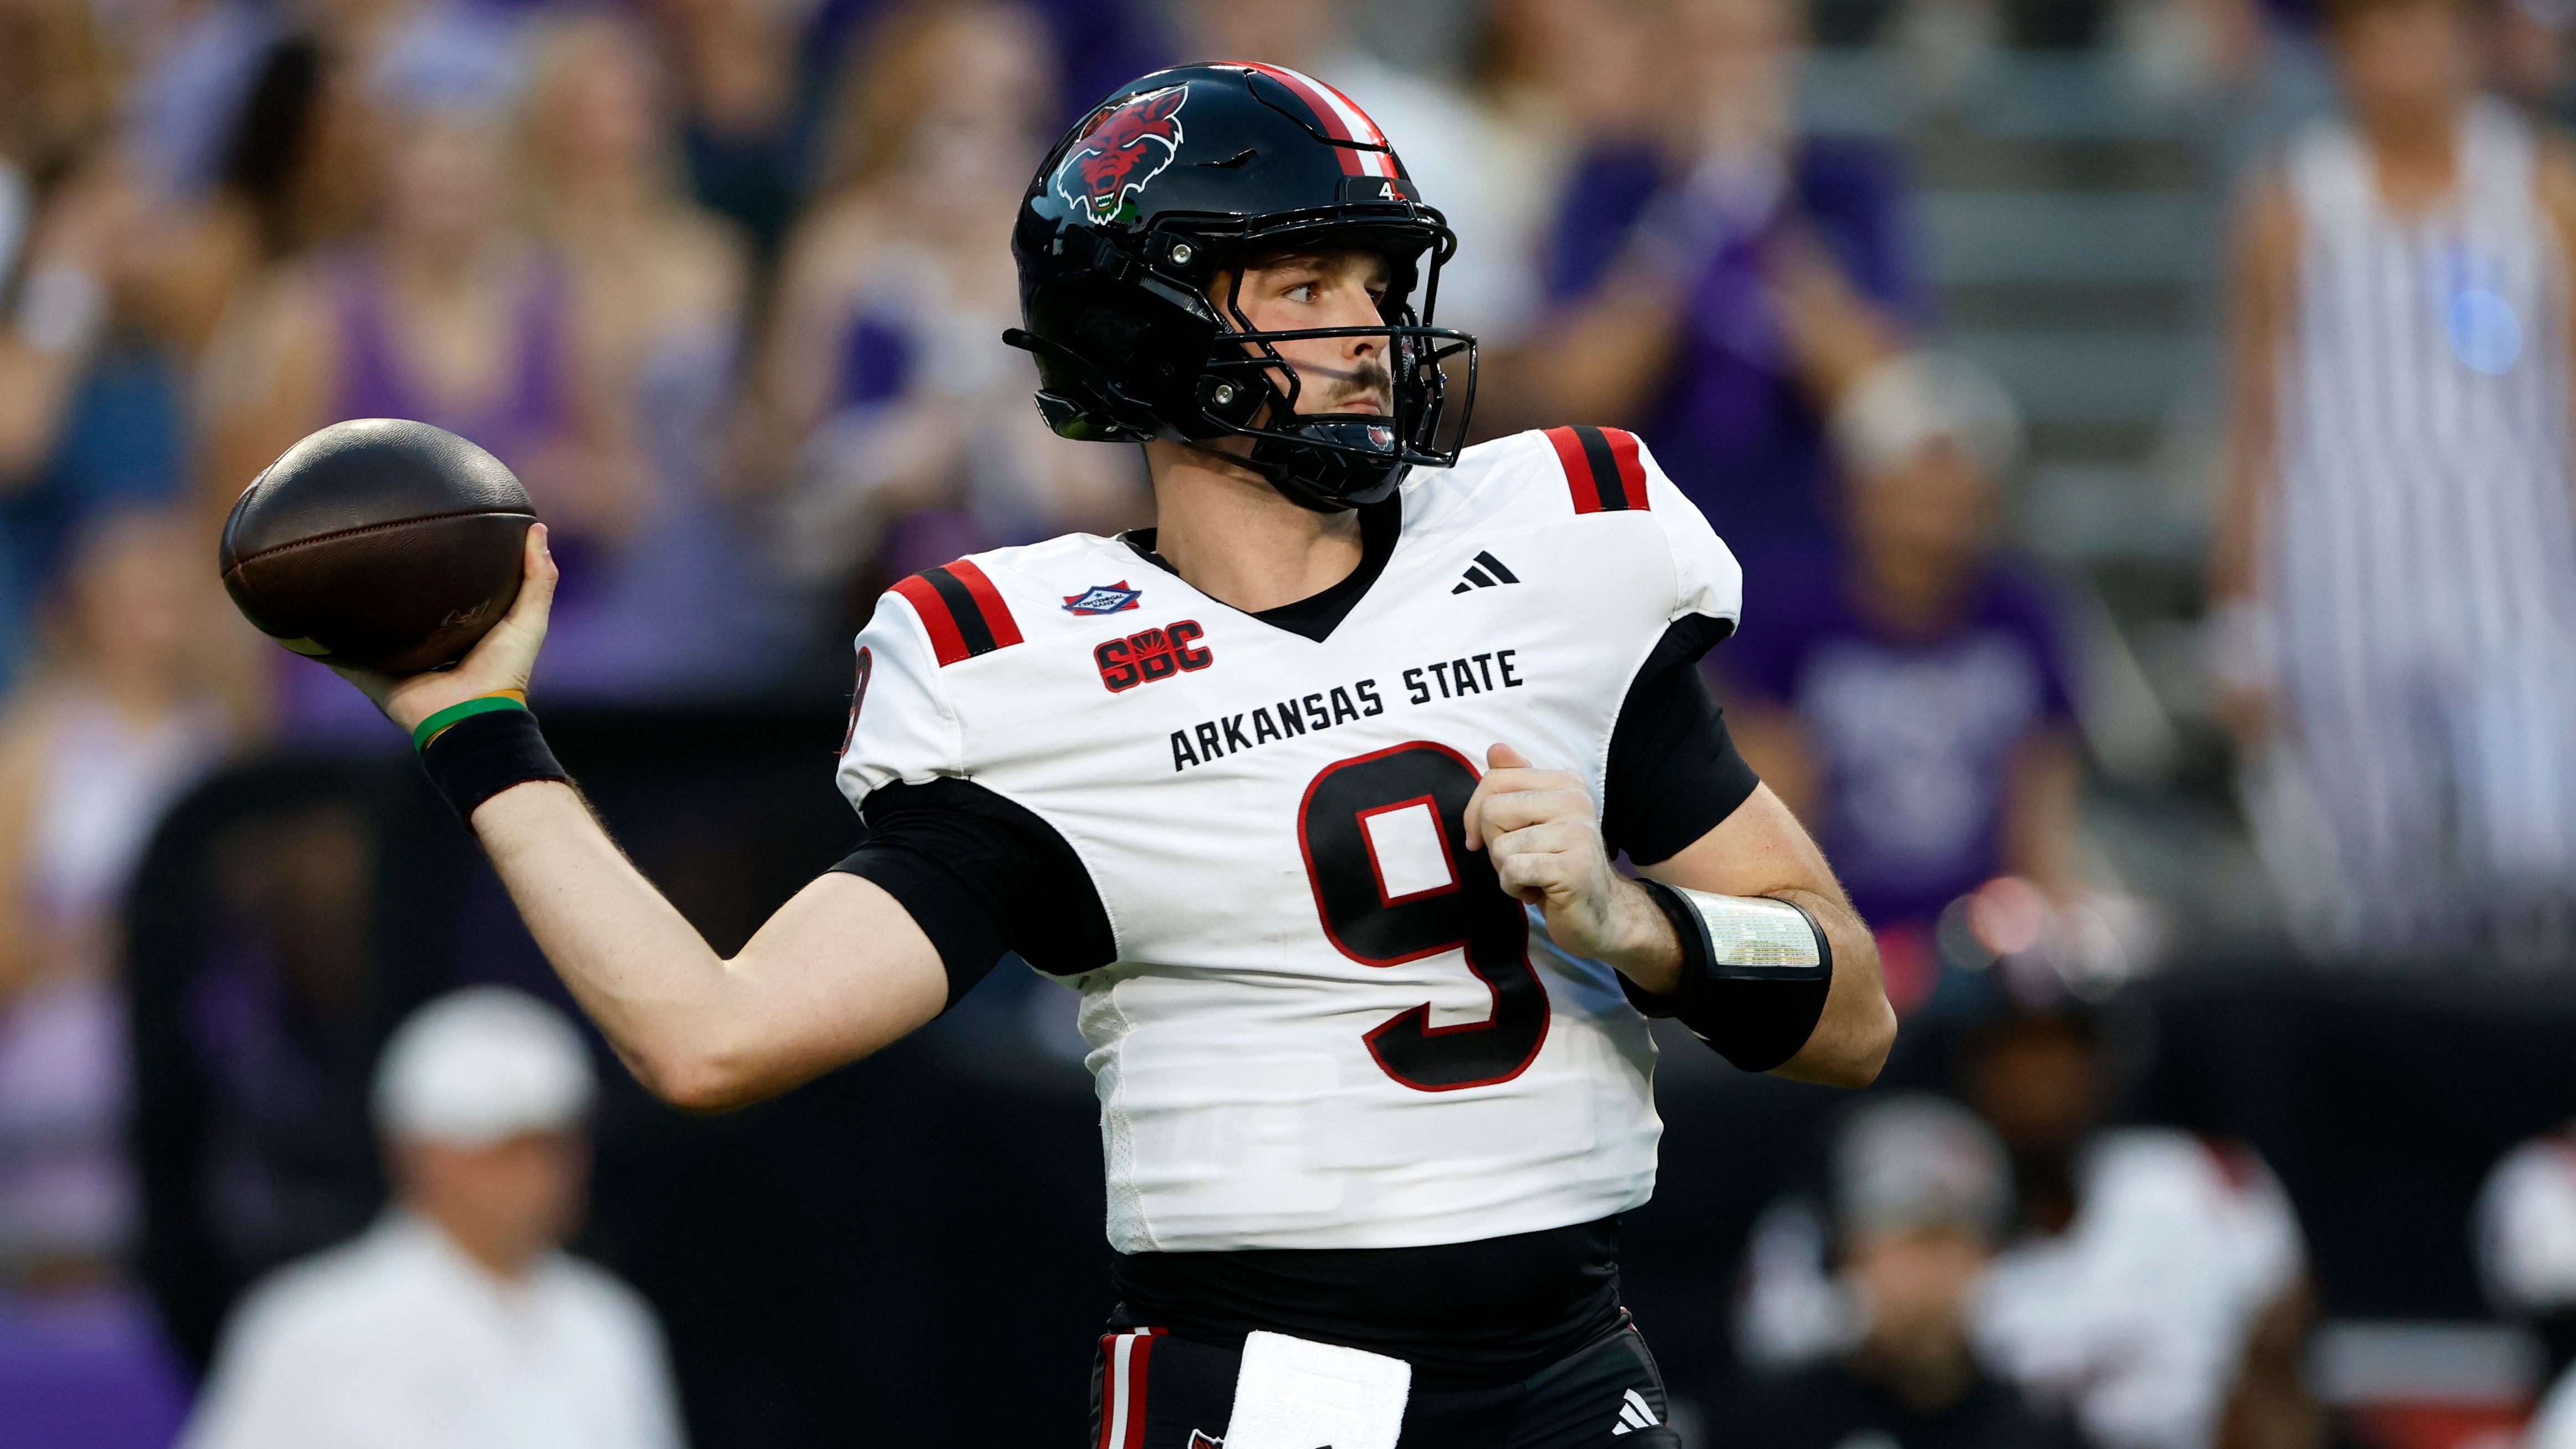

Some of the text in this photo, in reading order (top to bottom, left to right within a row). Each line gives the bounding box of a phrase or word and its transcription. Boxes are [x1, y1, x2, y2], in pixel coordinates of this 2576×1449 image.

[1078, 594, 1125, 607] CENTENNIAL
[1093, 619, 1213, 693] SBC
[1170, 649, 1523, 772] ARKANSAS STATE
[1297, 739, 1551, 1093] 9
